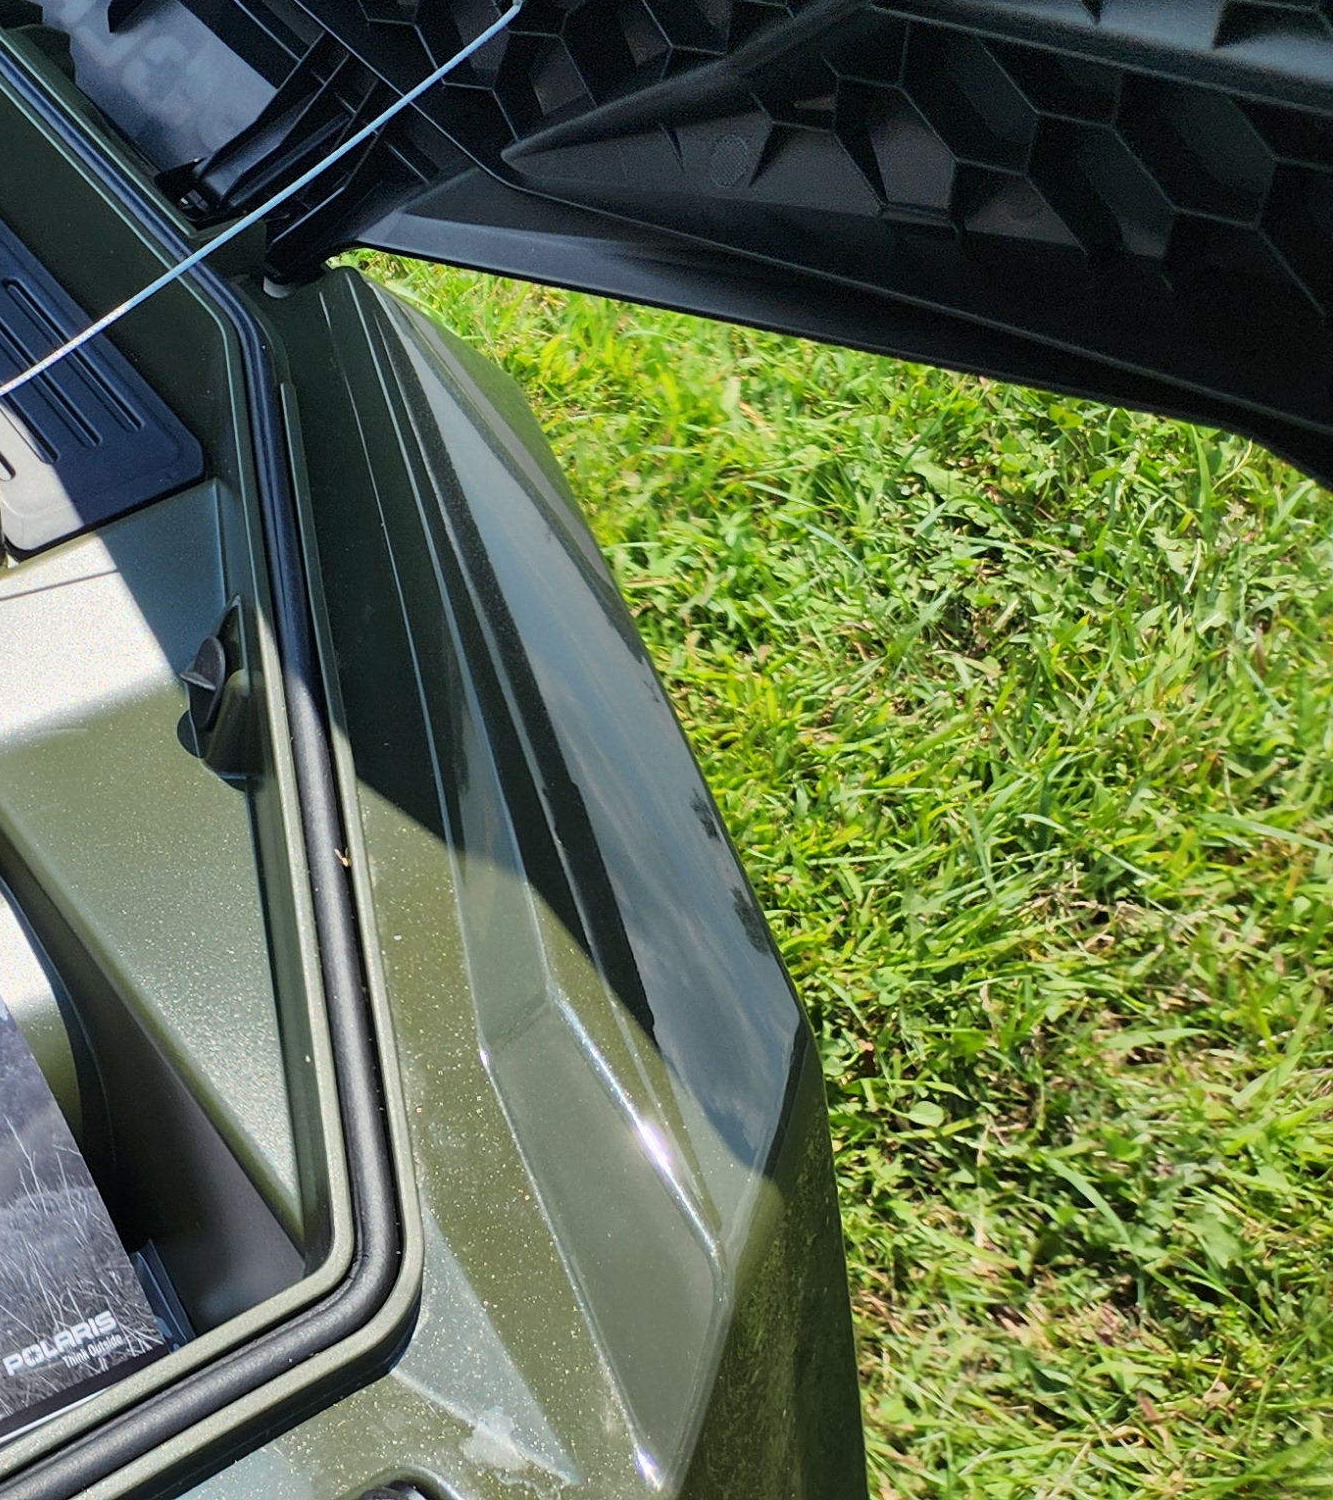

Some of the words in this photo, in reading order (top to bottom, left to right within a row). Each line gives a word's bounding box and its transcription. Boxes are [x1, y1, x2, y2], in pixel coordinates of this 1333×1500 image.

[4, 1311, 117, 1376] POLARIS
[63, 1347, 88, 1368] Think
[88, 1334, 123, 1357] Outside
